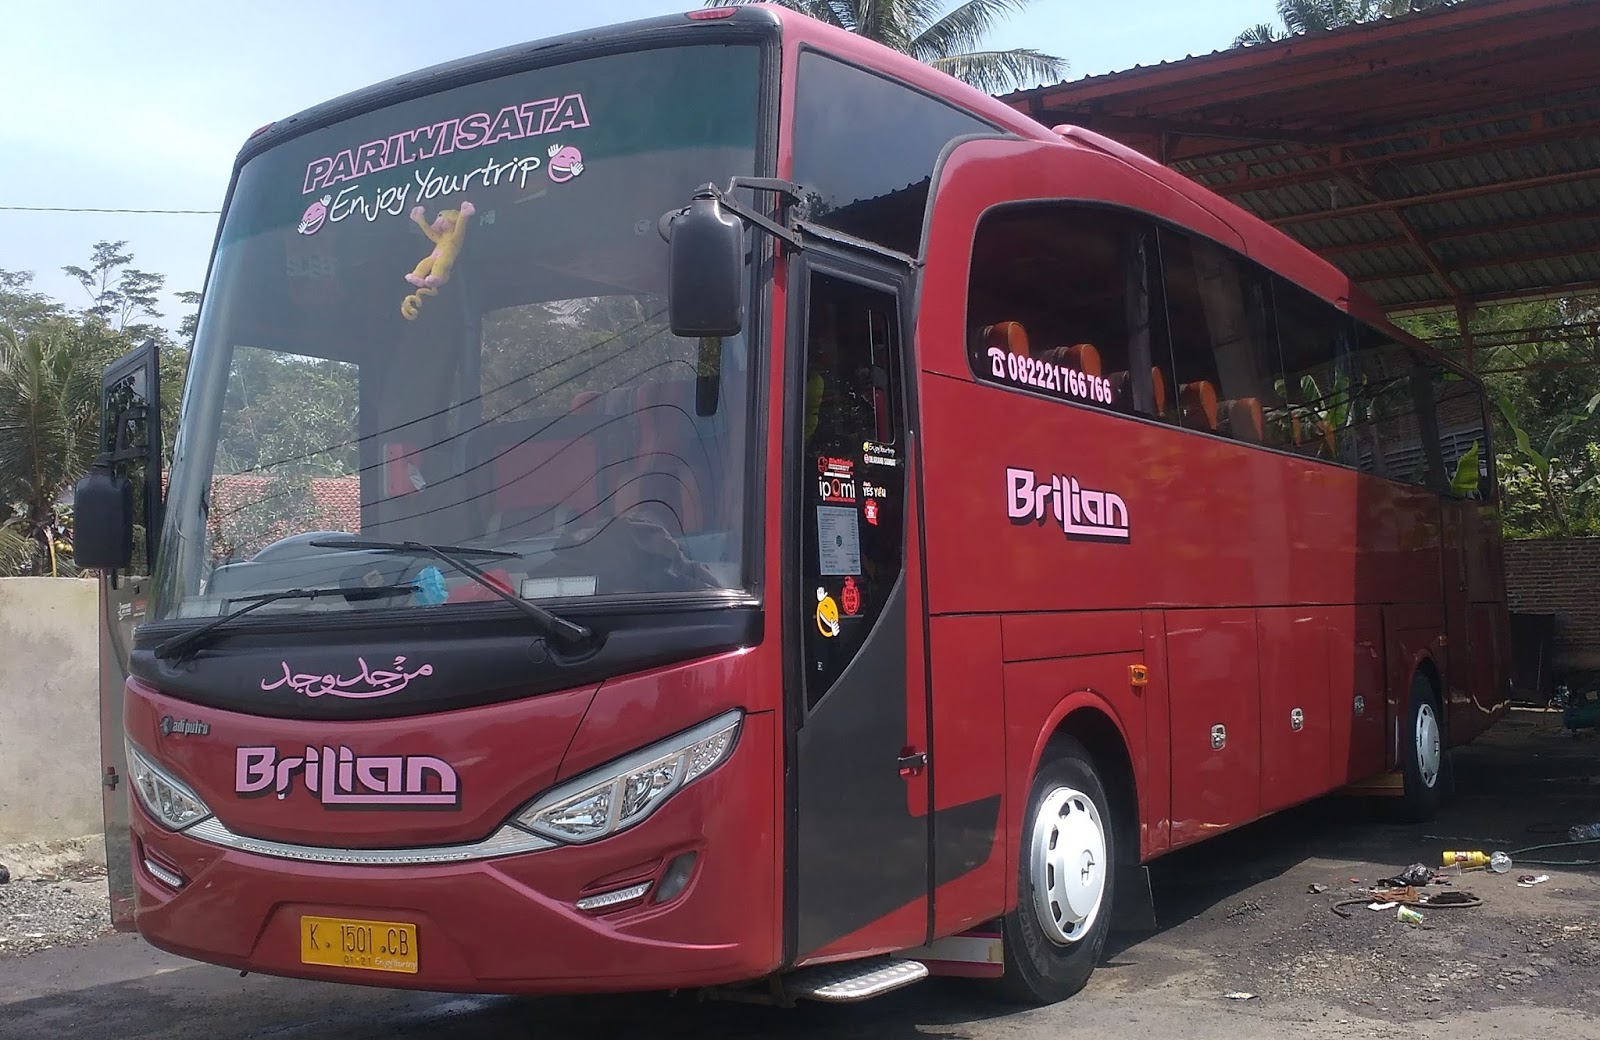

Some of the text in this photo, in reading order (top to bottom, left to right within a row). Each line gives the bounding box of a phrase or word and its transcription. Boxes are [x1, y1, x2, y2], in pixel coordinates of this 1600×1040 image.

[302, 93, 590, 194] PARIWISATA
[329, 183, 411, 222] Enjoy
[1006, 467, 1129, 538] Brilian
[235, 745, 457, 804] Brilian
[341, 926, 373, 953] 1501
